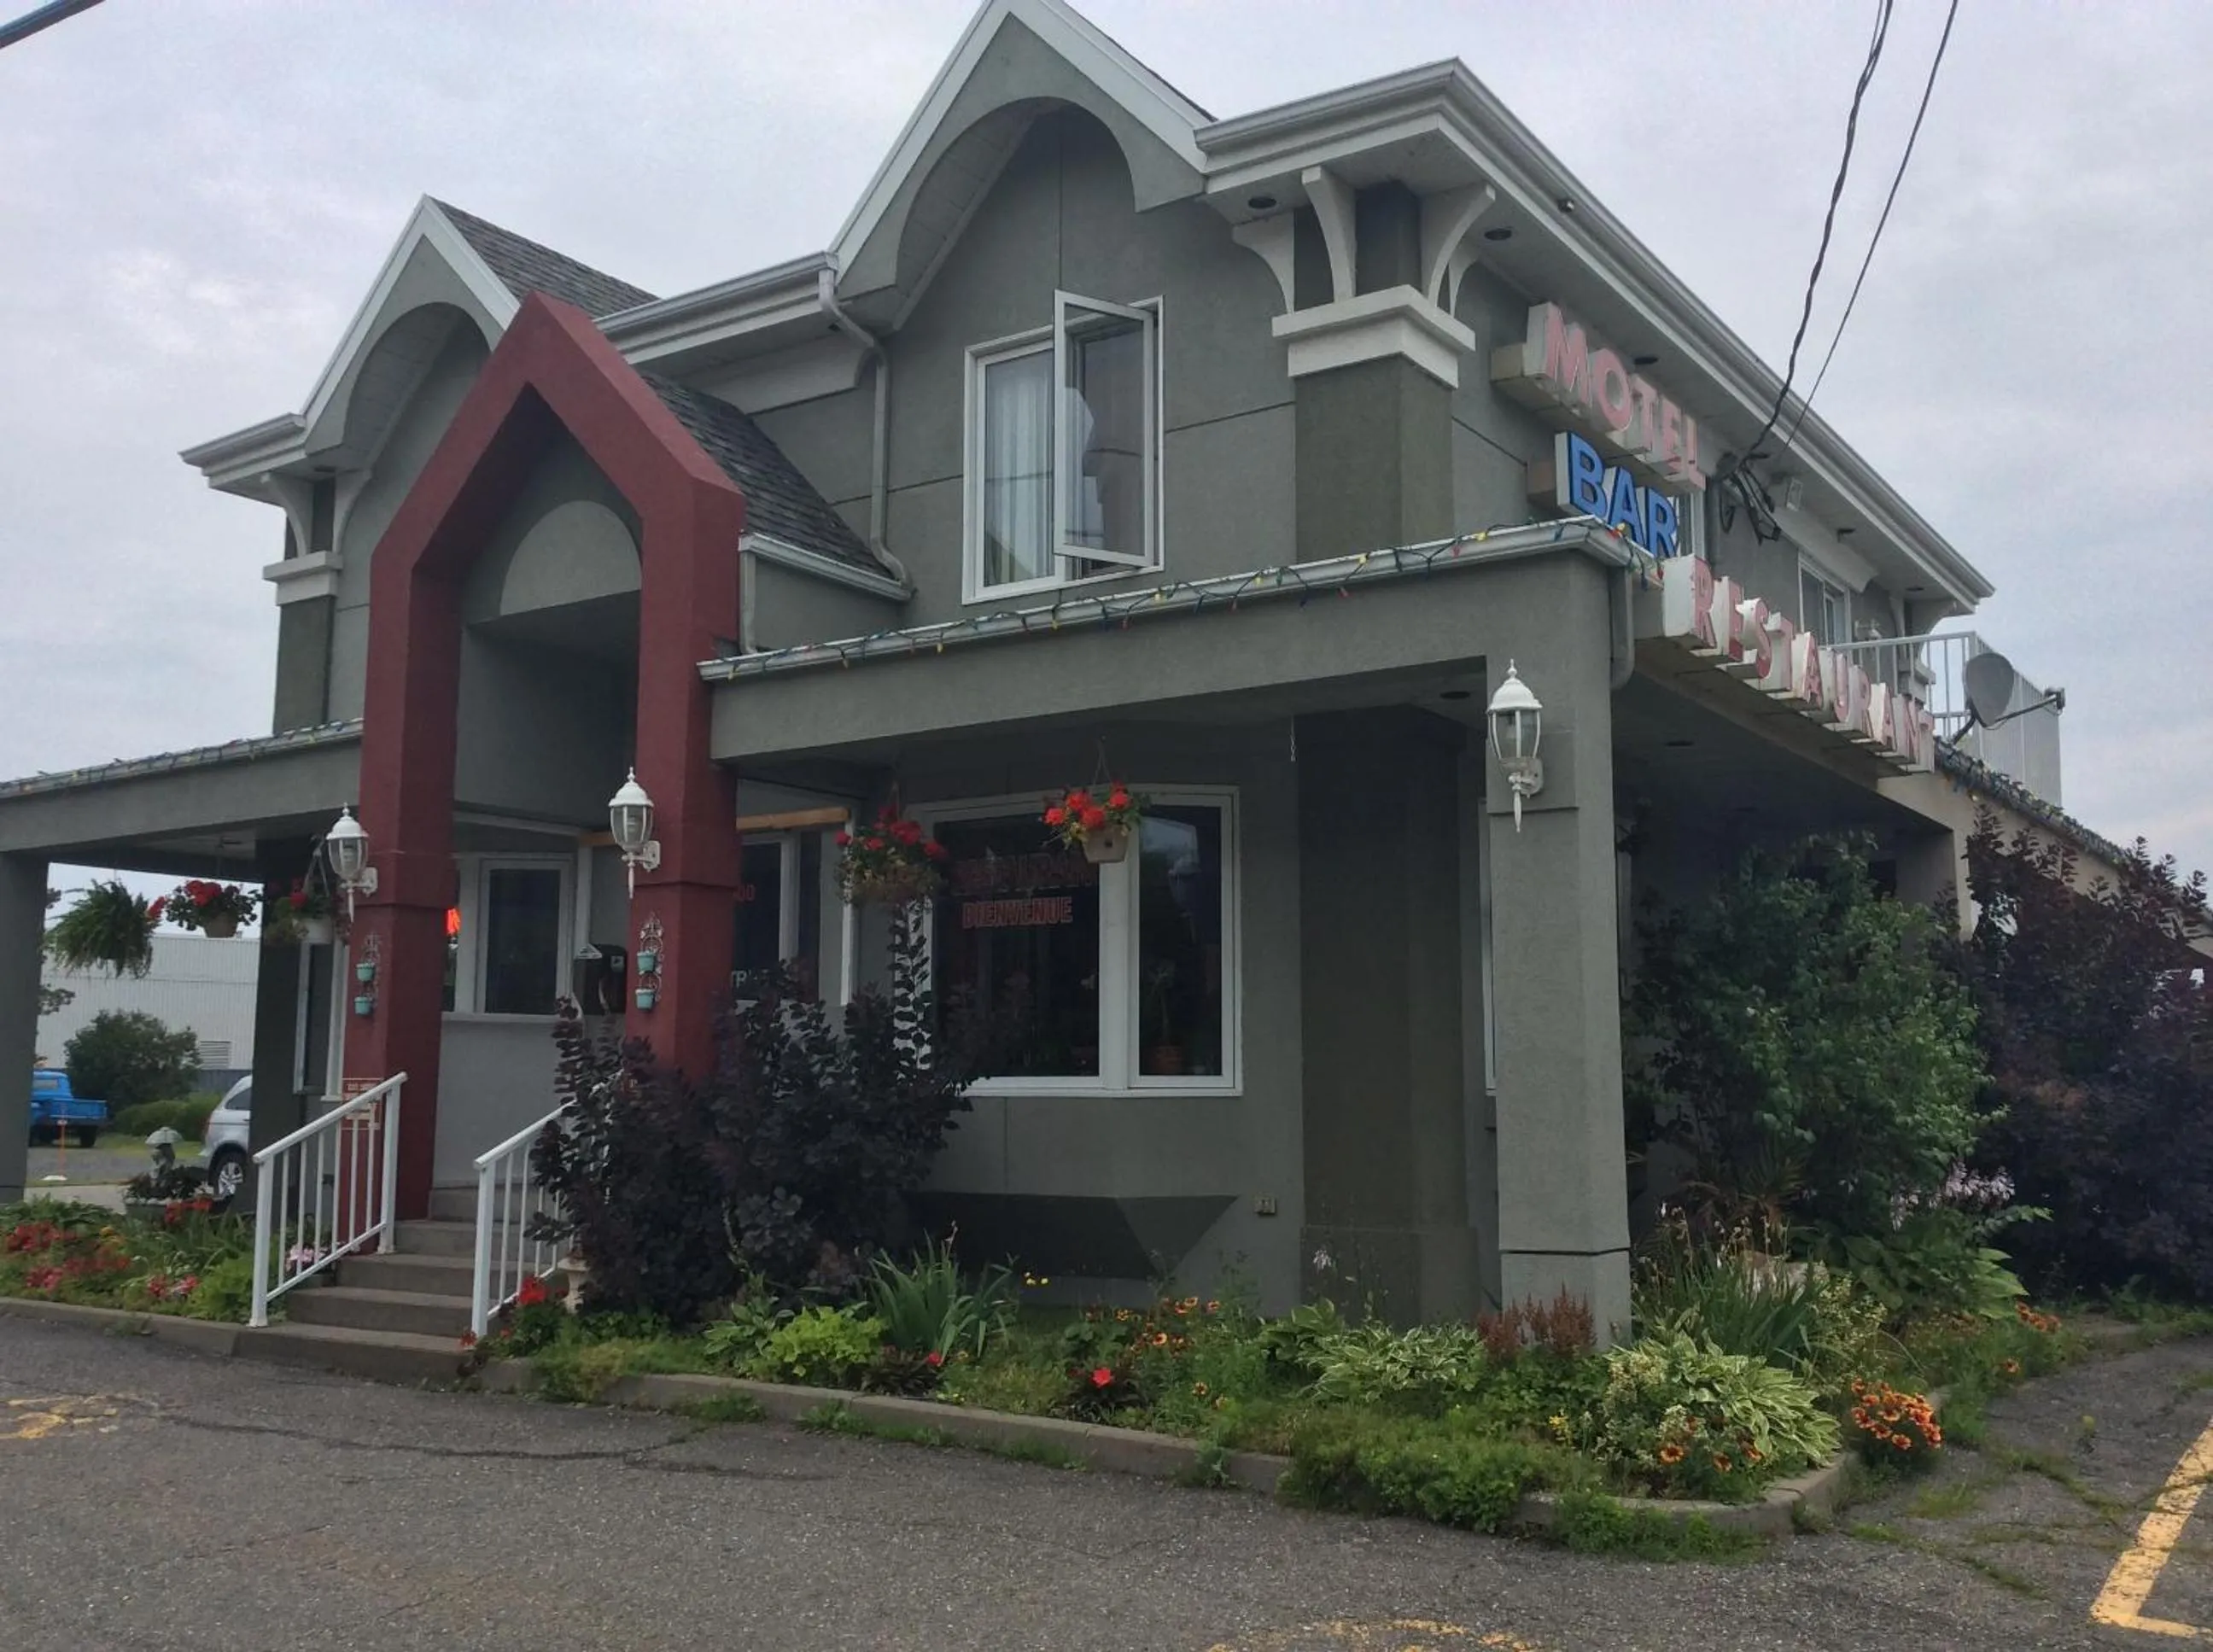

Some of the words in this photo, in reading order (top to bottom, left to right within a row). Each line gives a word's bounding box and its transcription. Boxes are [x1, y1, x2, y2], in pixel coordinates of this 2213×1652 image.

[1542, 301, 1706, 491] MOTEL
[1567, 431, 1679, 558] BAR
[1691, 554, 1936, 770] RESTAURANT
